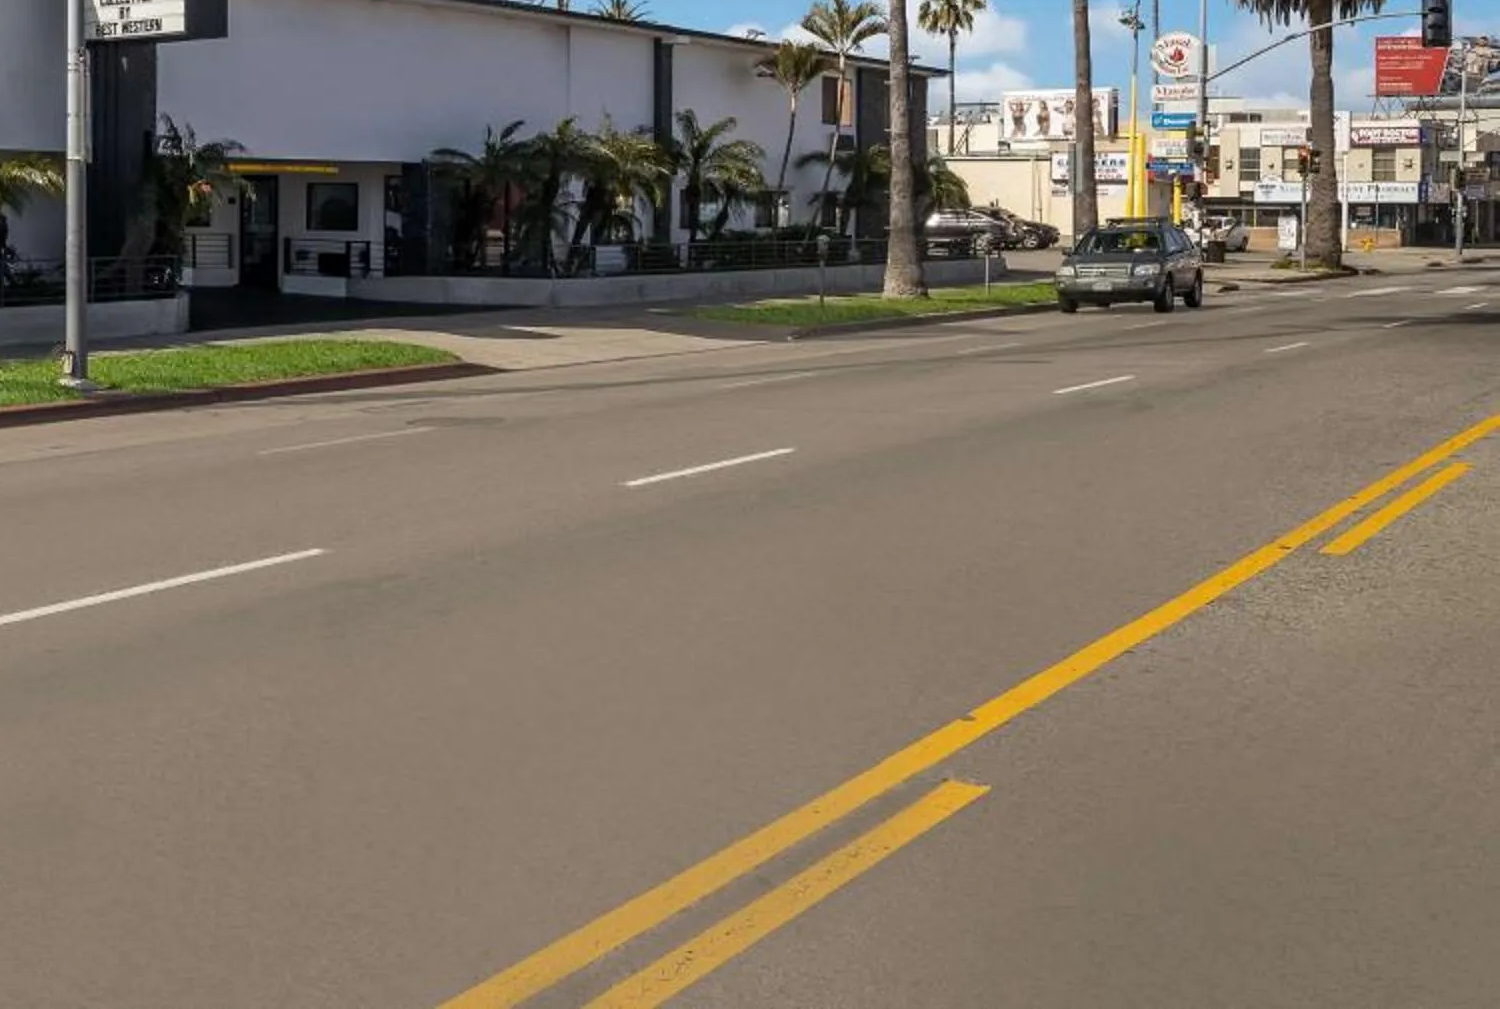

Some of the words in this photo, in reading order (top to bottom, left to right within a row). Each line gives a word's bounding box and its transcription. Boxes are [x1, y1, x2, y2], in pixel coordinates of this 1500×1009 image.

[119, 6, 131, 20] BY
[95, 22, 118, 37] BEST
[121, 18, 163, 34] WESTERN
